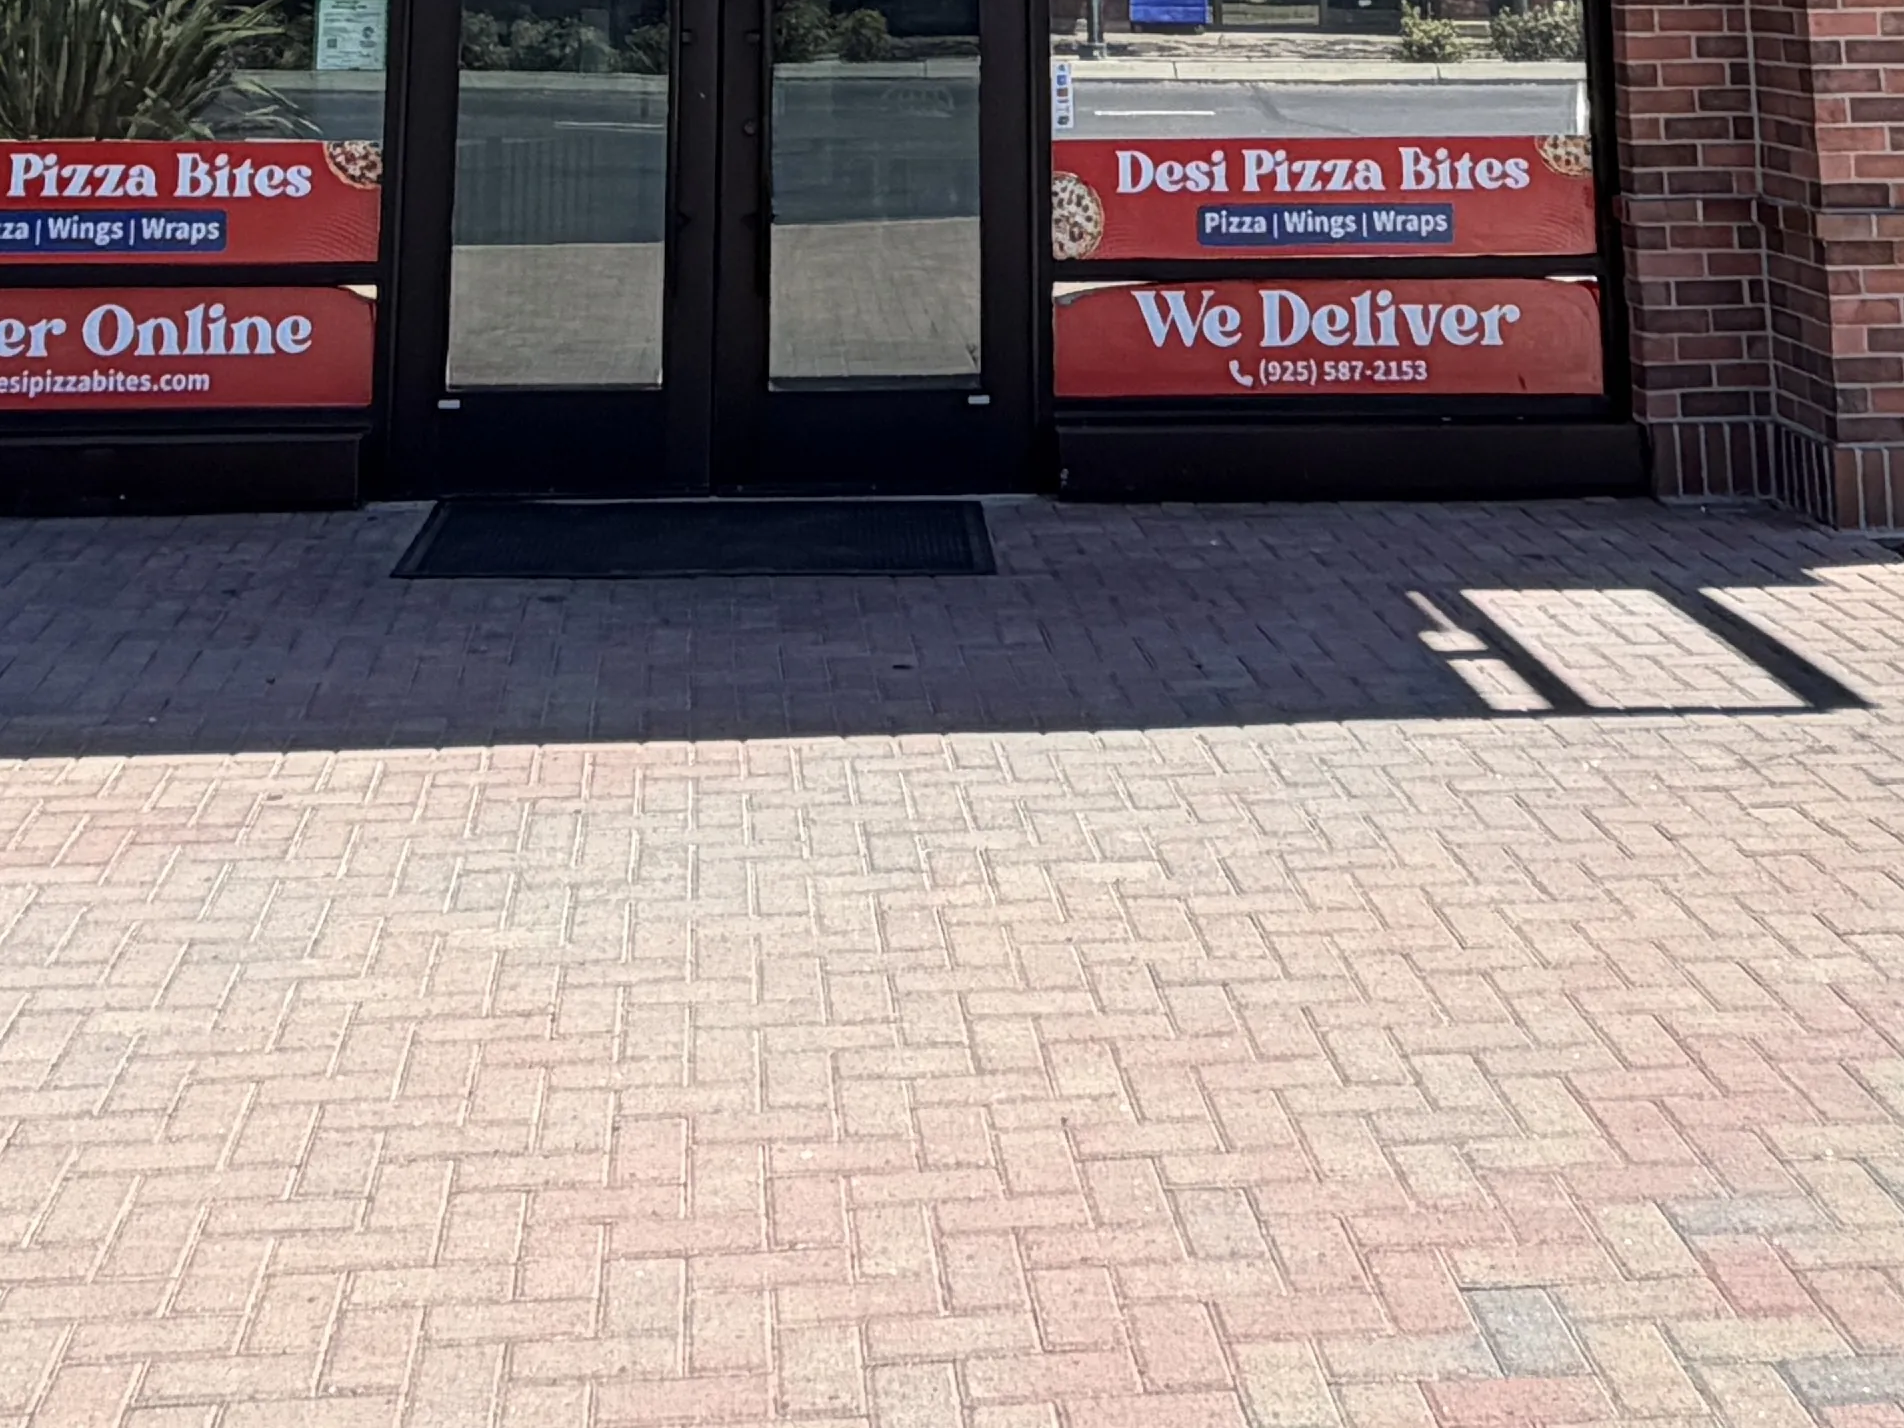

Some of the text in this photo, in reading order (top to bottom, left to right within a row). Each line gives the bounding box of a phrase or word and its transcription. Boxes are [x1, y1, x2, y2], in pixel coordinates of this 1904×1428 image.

[7, 152, 158, 199] Pizza
[174, 152, 313, 198] Bites
[1115, 146, 1531, 194] Desi Pizza Bites
[47, 216, 124, 246] Wings
[141, 216, 221, 247] Wraps
[1204, 212, 1267, 235] Pizza
[1284, 212, 1357, 238] Wings
[1372, 211, 1448, 237] Wraps
[82, 302, 313, 357] Online
[1131, 289, 1521, 348] We Deliver
[1258, 359, 1429, 387] (925) 587-2153
